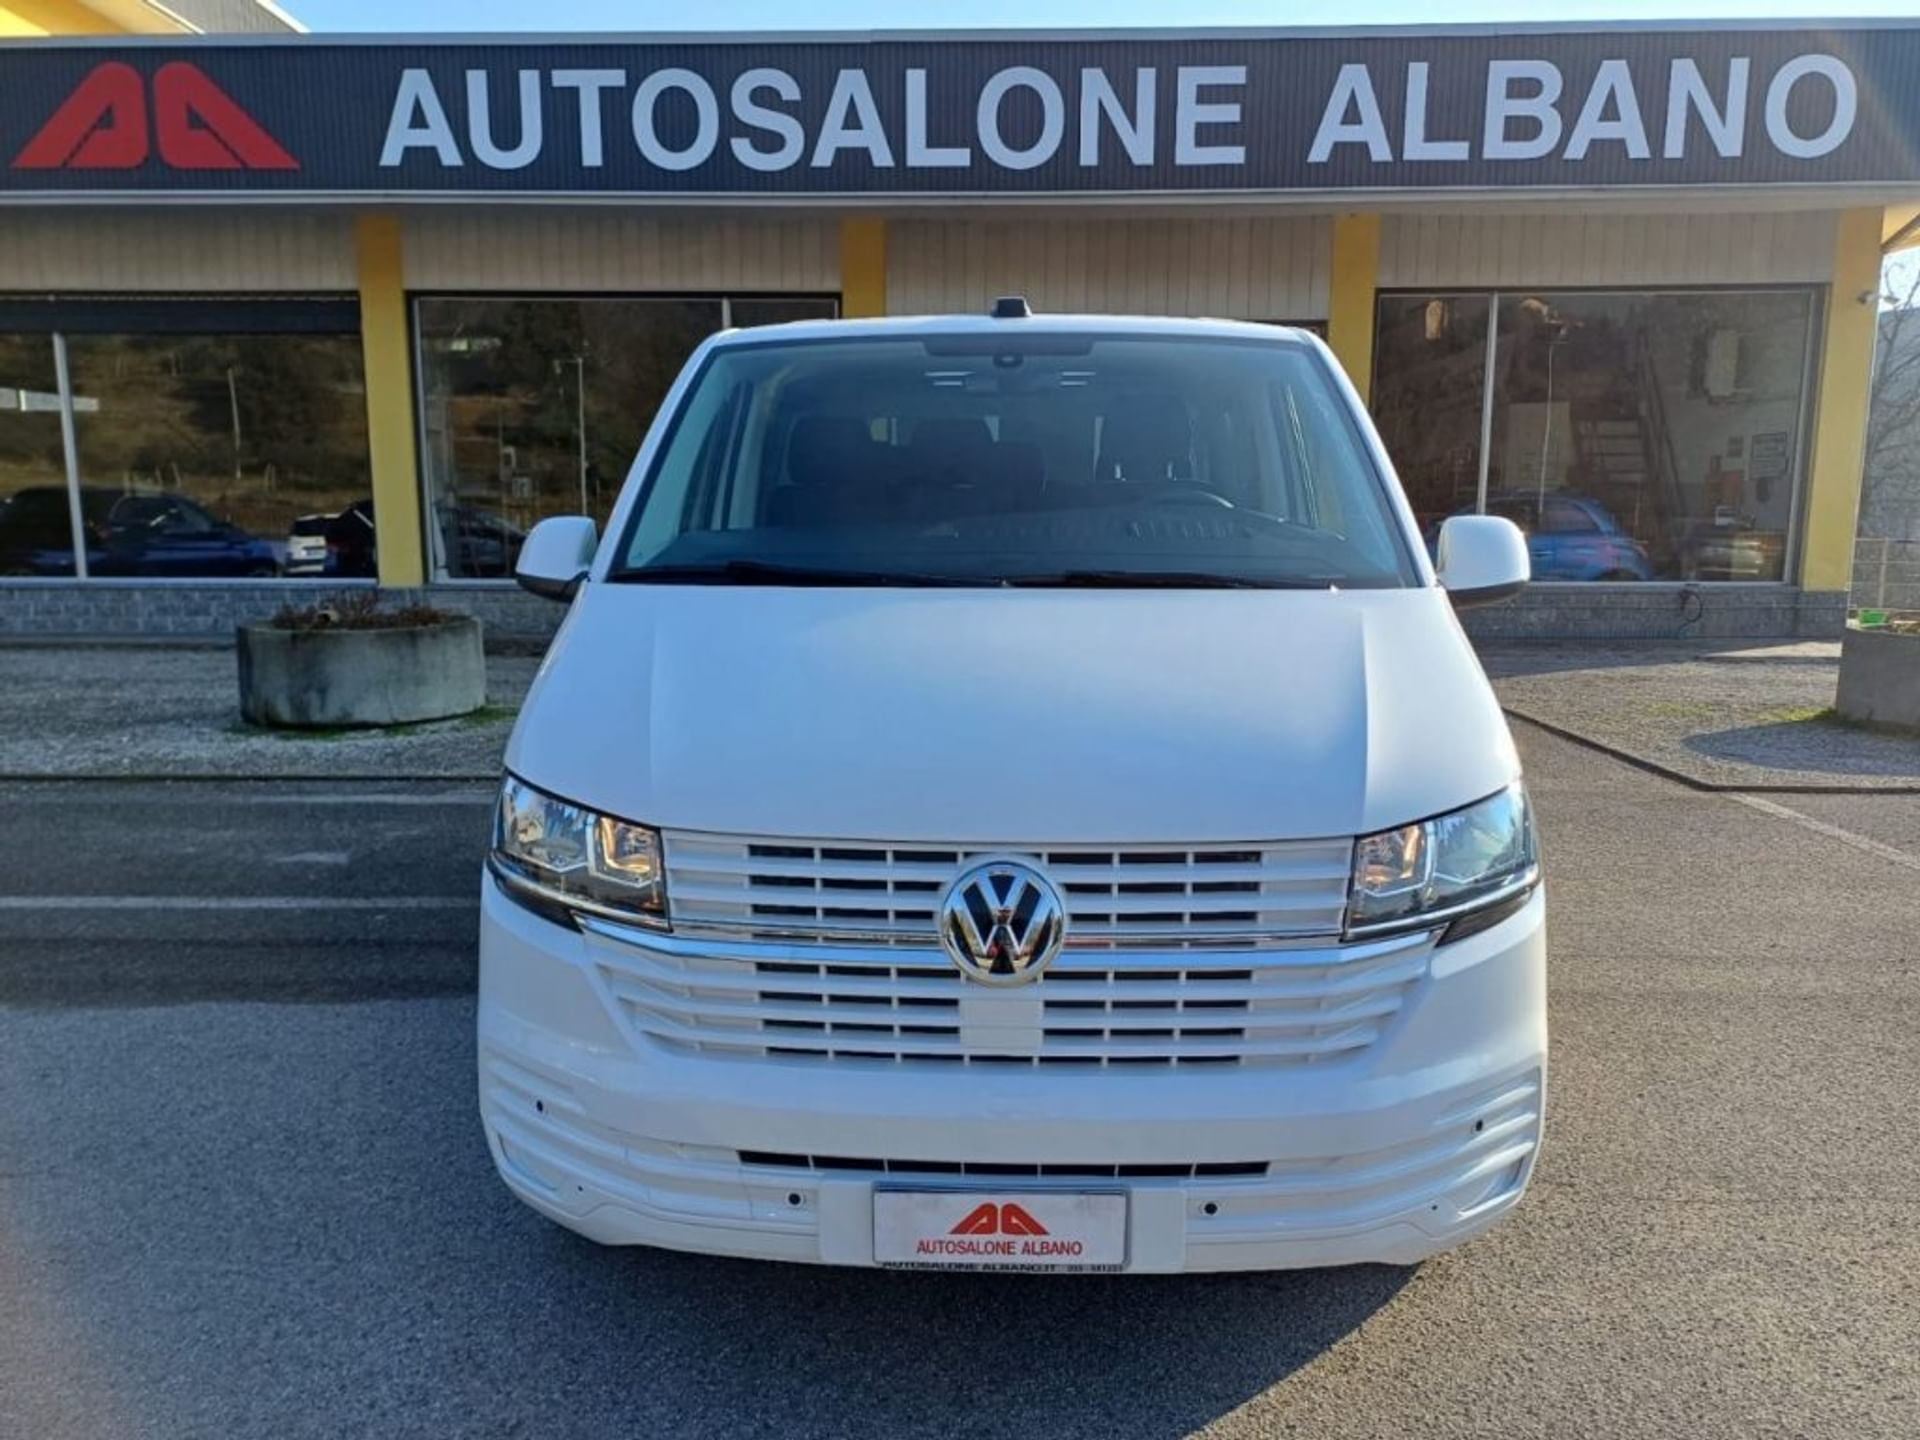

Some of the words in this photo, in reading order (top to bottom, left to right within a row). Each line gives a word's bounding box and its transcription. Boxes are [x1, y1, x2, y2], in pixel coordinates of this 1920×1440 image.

[379, 65, 1247, 172] AUTOSALONE
[1306, 53, 1858, 165] ALBANO
[916, 1240, 1016, 1256] AUTOSALONE
[1021, 1240, 1083, 1256] ALBANO
